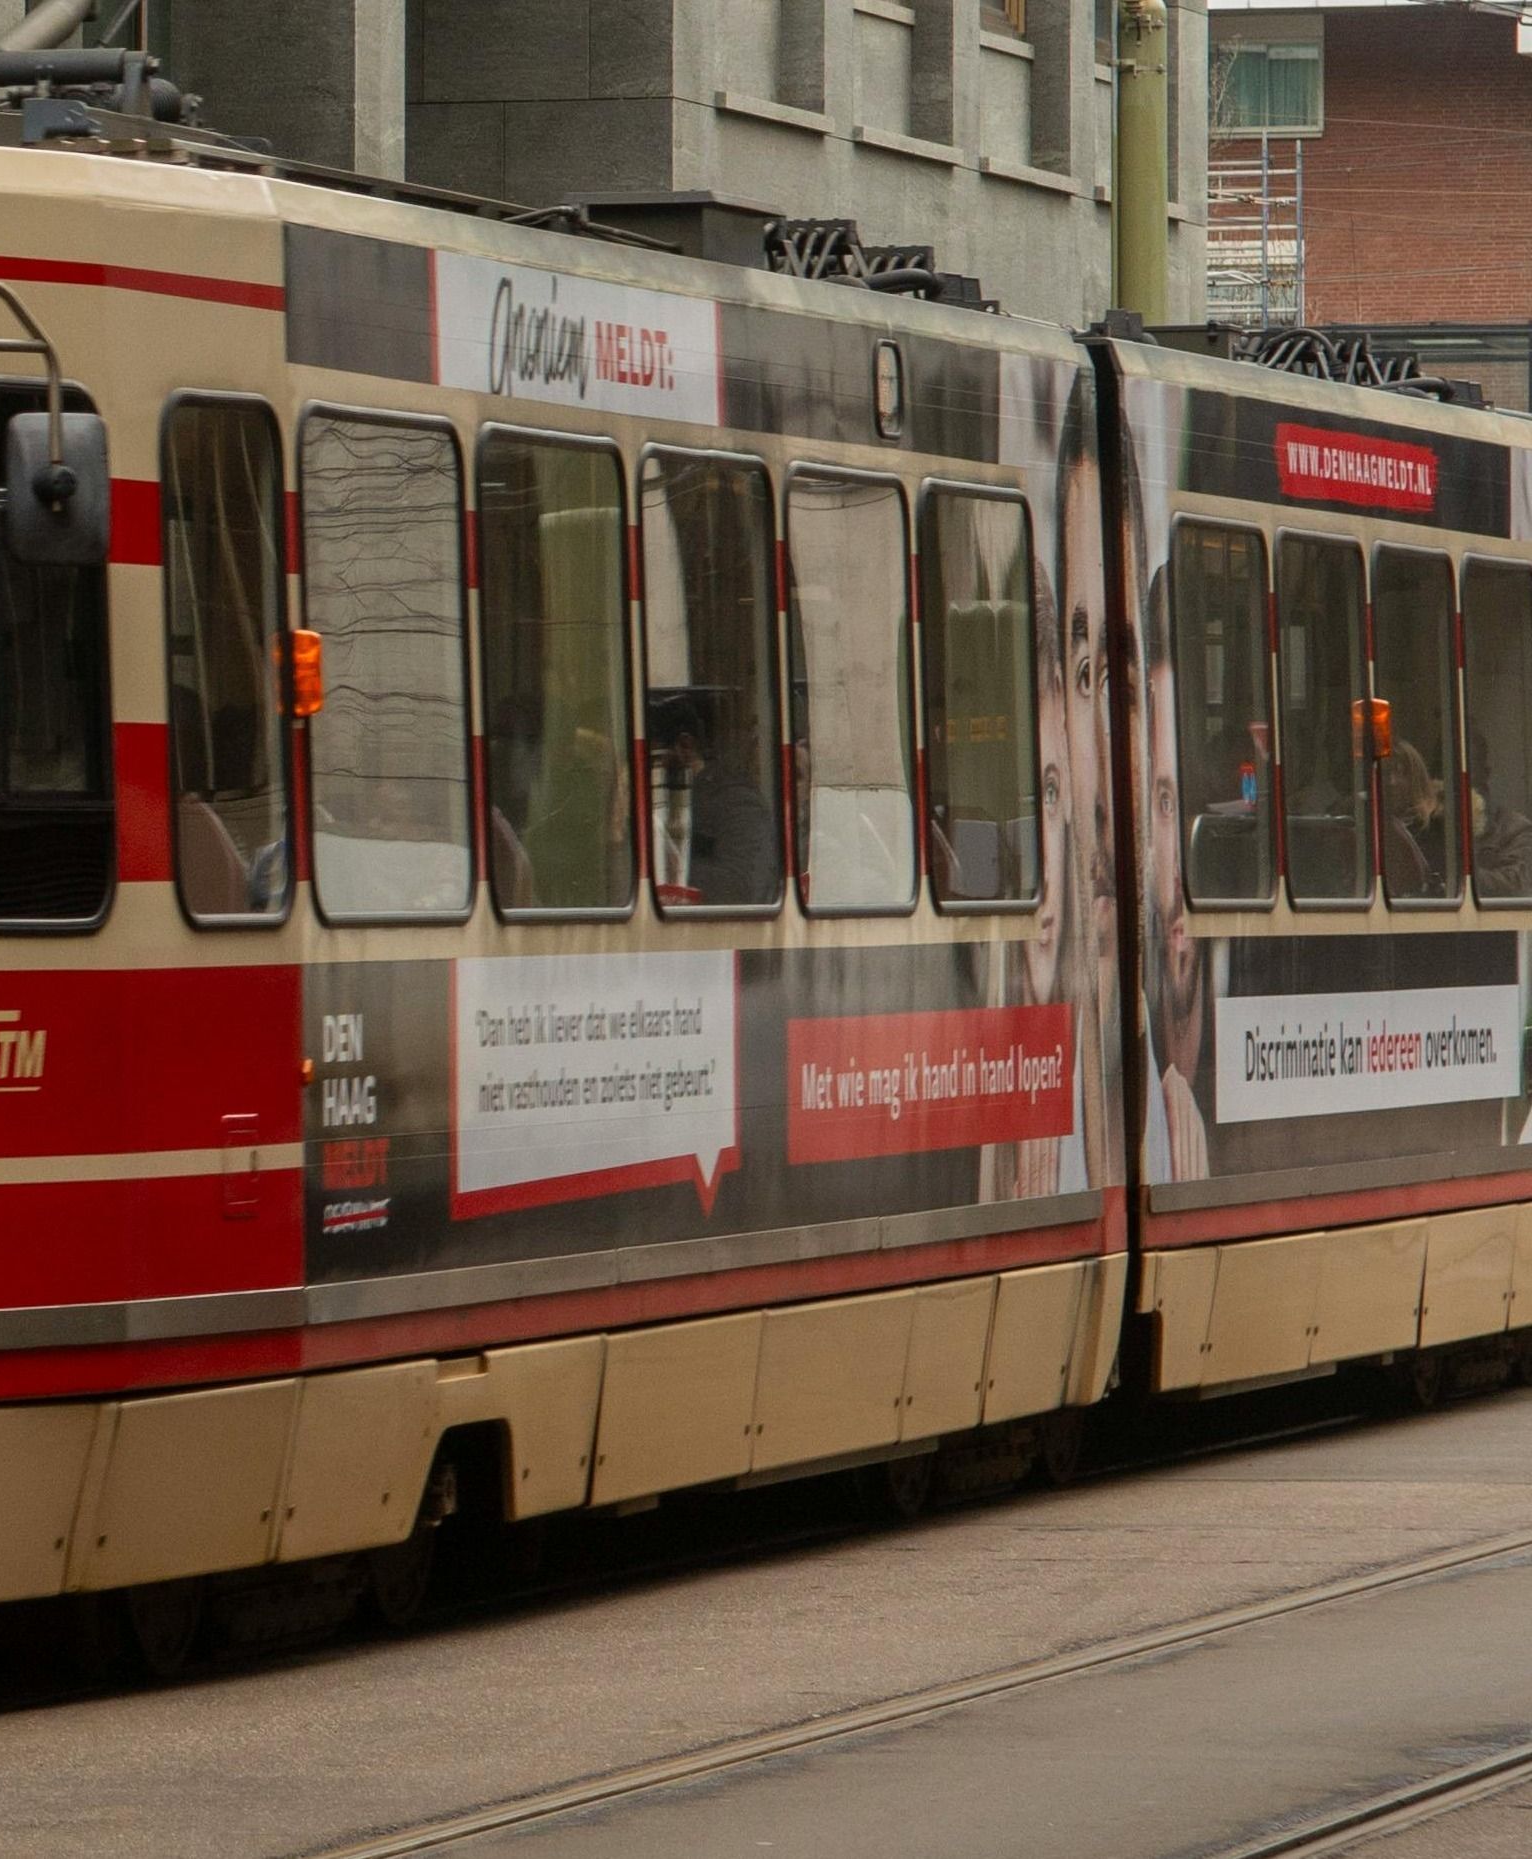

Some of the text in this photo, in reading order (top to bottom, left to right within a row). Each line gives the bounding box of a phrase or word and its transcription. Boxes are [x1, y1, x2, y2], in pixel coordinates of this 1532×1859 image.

[595, 320, 674, 391] MELDT:
[1286, 441, 1432, 496] WWW.DENHAAGMELDT.NL
[323, 1014, 364, 1063] DEN
[507, 1005, 531, 1046] heb
[534, 1004, 546, 1044] ik
[548, 1003, 582, 1043] liever
[585, 1001, 606, 1041] dat
[608, 1012, 626, 1040] we
[629, 999, 671, 1039] elkaars
[674, 996, 703, 1036] hand
[1245, 1013, 1498, 1082] Discriminatie kan iedereen overkomen.
[323, 1075, 377, 1127] HAAG
[478, 1071, 505, 1112] niet
[507, 1066, 580, 1110] vasthouden
[583, 1077, 599, 1105] en
[600, 1062, 636, 1104] zoiets
[639, 1060, 662, 1101] niet
[801, 1044, 1063, 1121] Met wie mag ik hand in hand lopen?
